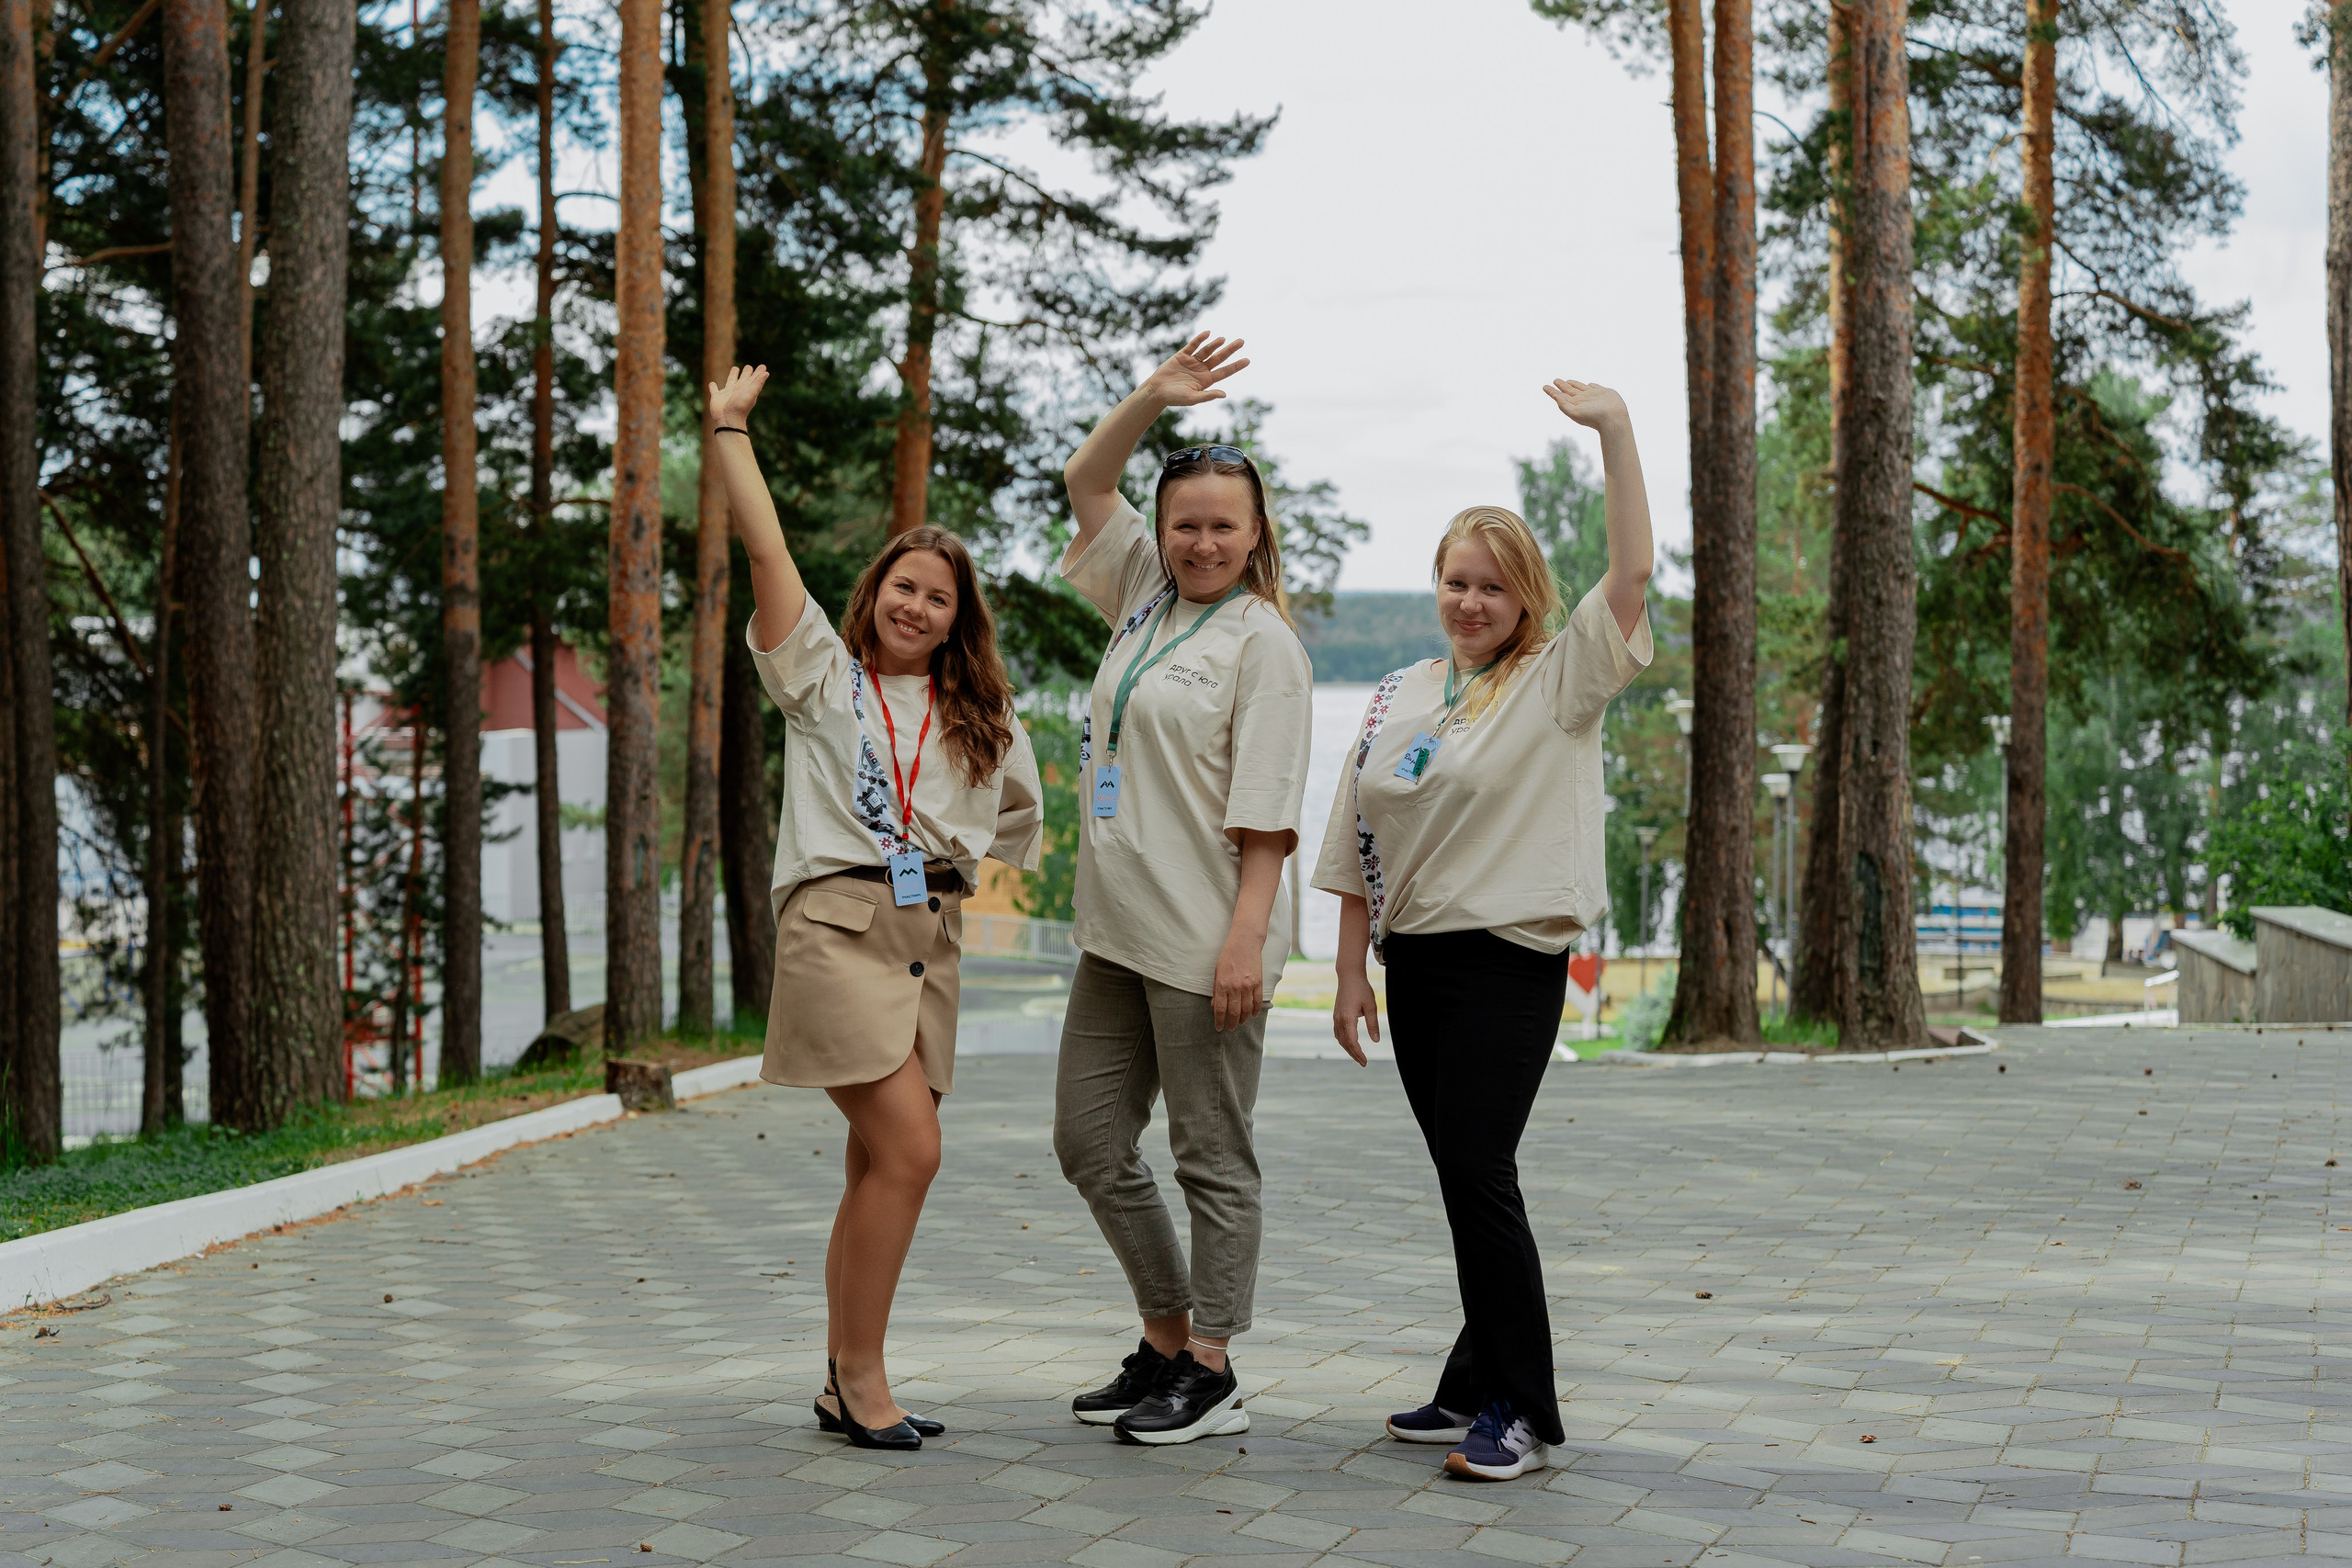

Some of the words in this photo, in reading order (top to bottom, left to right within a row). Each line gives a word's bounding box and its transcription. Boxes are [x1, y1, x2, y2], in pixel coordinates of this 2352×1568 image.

[1161, 673, 1192, 687] урала
[1170, 664, 1191, 674] друг
[1198, 676, 1218, 688] юга
